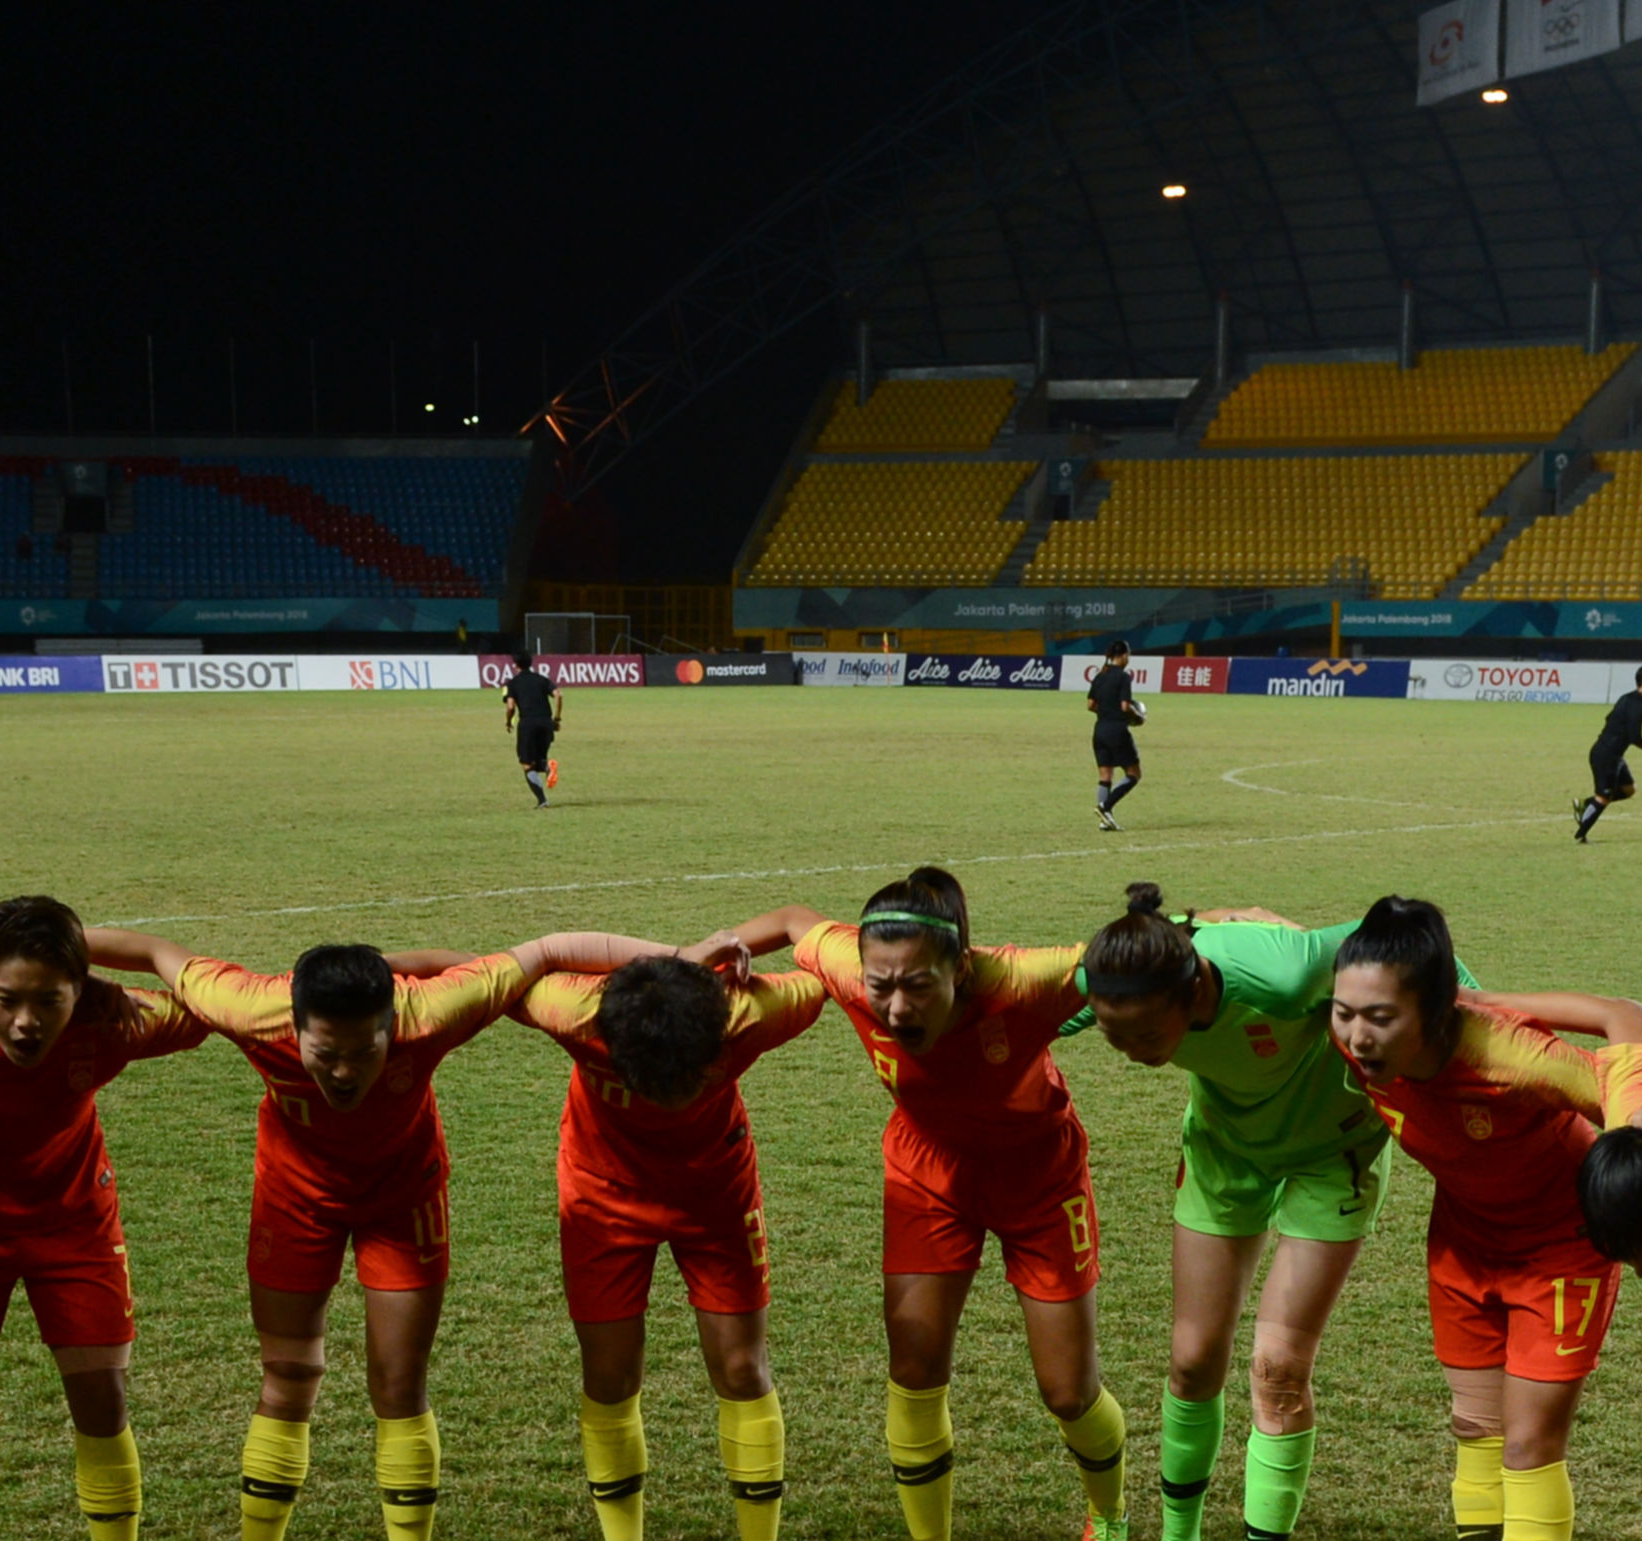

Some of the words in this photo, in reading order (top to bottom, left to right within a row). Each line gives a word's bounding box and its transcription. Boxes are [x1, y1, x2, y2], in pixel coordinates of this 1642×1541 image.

[954, 603, 1005, 617] Jakarta
[1085, 603, 1115, 616] 2018
[1342, 614, 1376, 624] Jakarta
[1378, 614, 1428, 627] Palembang
[1430, 614, 1453, 625] 2018
[28, 667, 60, 687] BRI
[161, 661, 294, 689] TISSOT
[379, 660, 431, 690] BNI
[483, 663, 551, 685] QAR
[557, 663, 640, 685] AIRWAYS
[707, 663, 766, 676] mastercard
[838, 658, 900, 676] Indofood
[908, 657, 950, 681] Aice
[957, 657, 1001, 681] Aice
[1009, 658, 1055, 683] Aice
[1176, 666, 1211, 687] 佳能
[1477, 668, 1561, 687] TOYOTA
[1268, 673, 1345, 696] mandiri
[1504, 690, 1522, 702] GO
[1524, 690, 1571, 702] BEYOND
[1062, 1195, 1091, 1253] 8
[1551, 1277, 1601, 1337] 17
